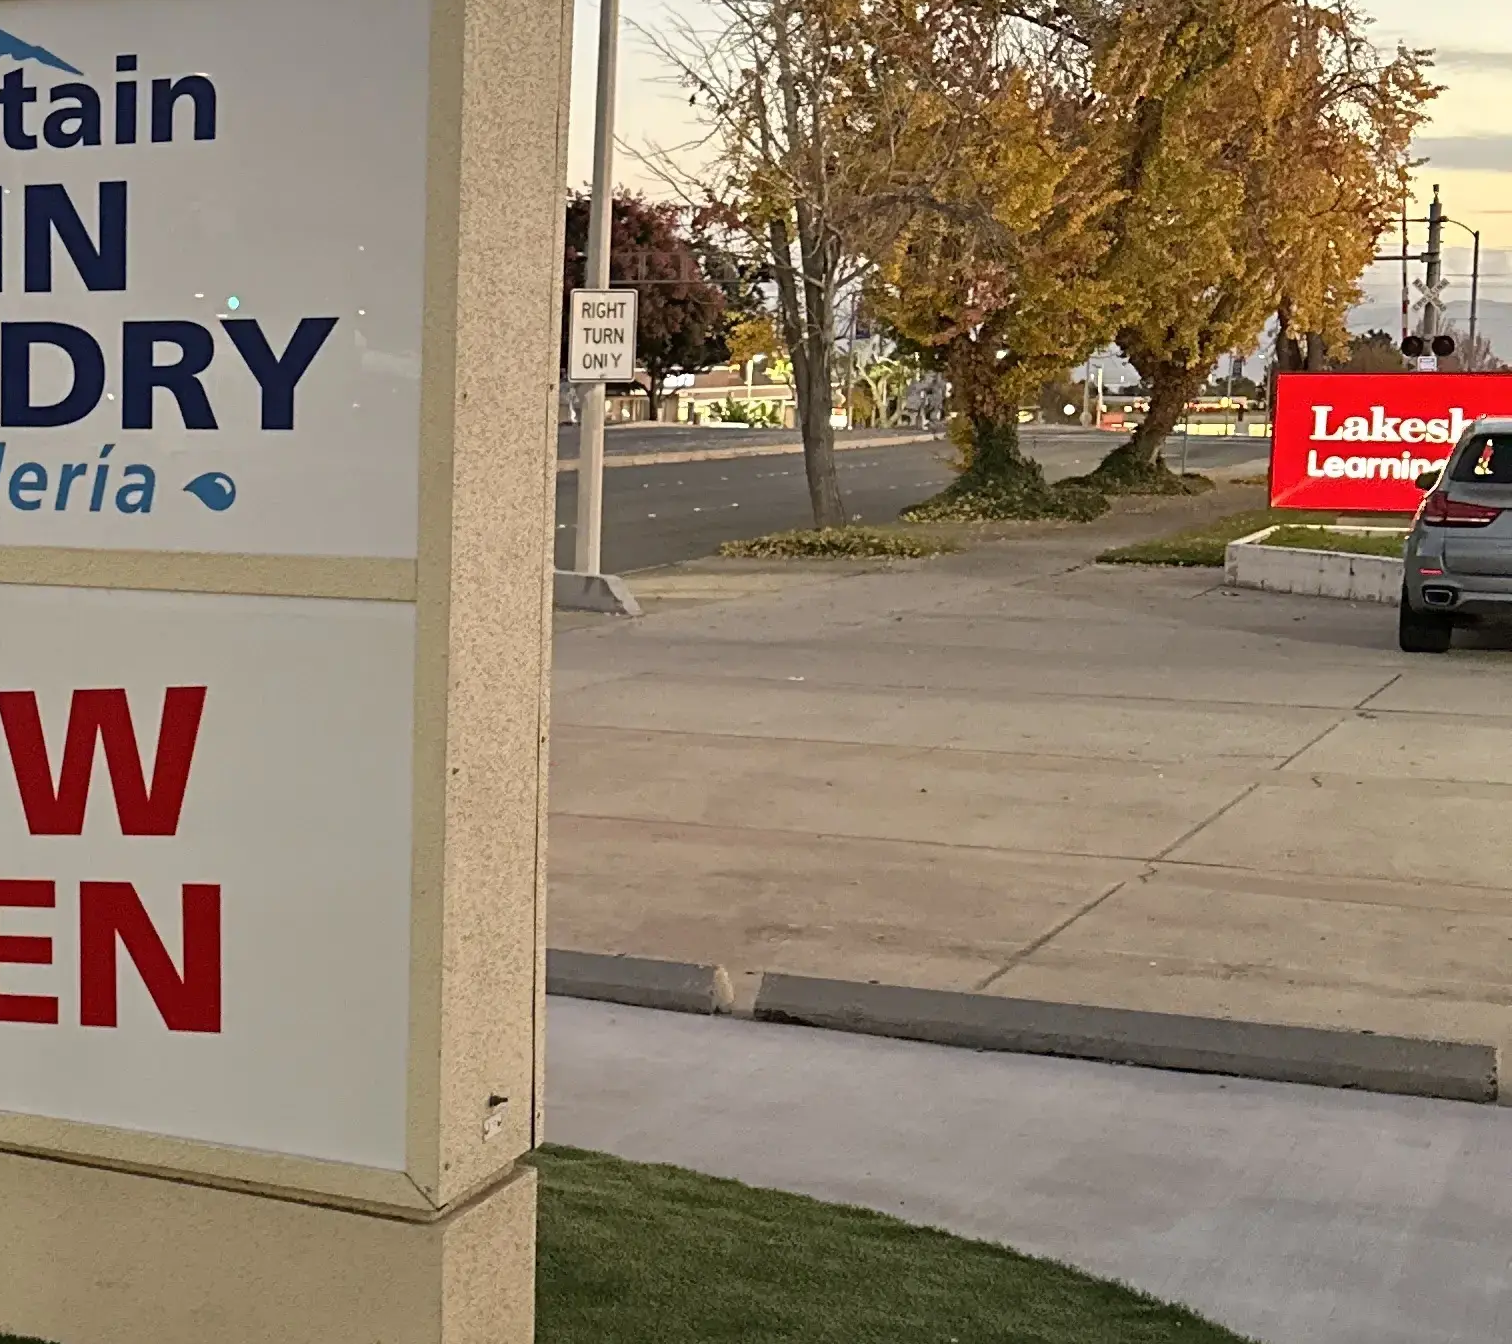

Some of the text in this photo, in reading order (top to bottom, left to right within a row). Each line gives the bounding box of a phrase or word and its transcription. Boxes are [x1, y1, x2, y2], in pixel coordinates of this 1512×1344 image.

[582, 302, 626, 319] RIGHT
[583, 327, 625, 344] TURN
[582, 353, 623, 370] ONLY
